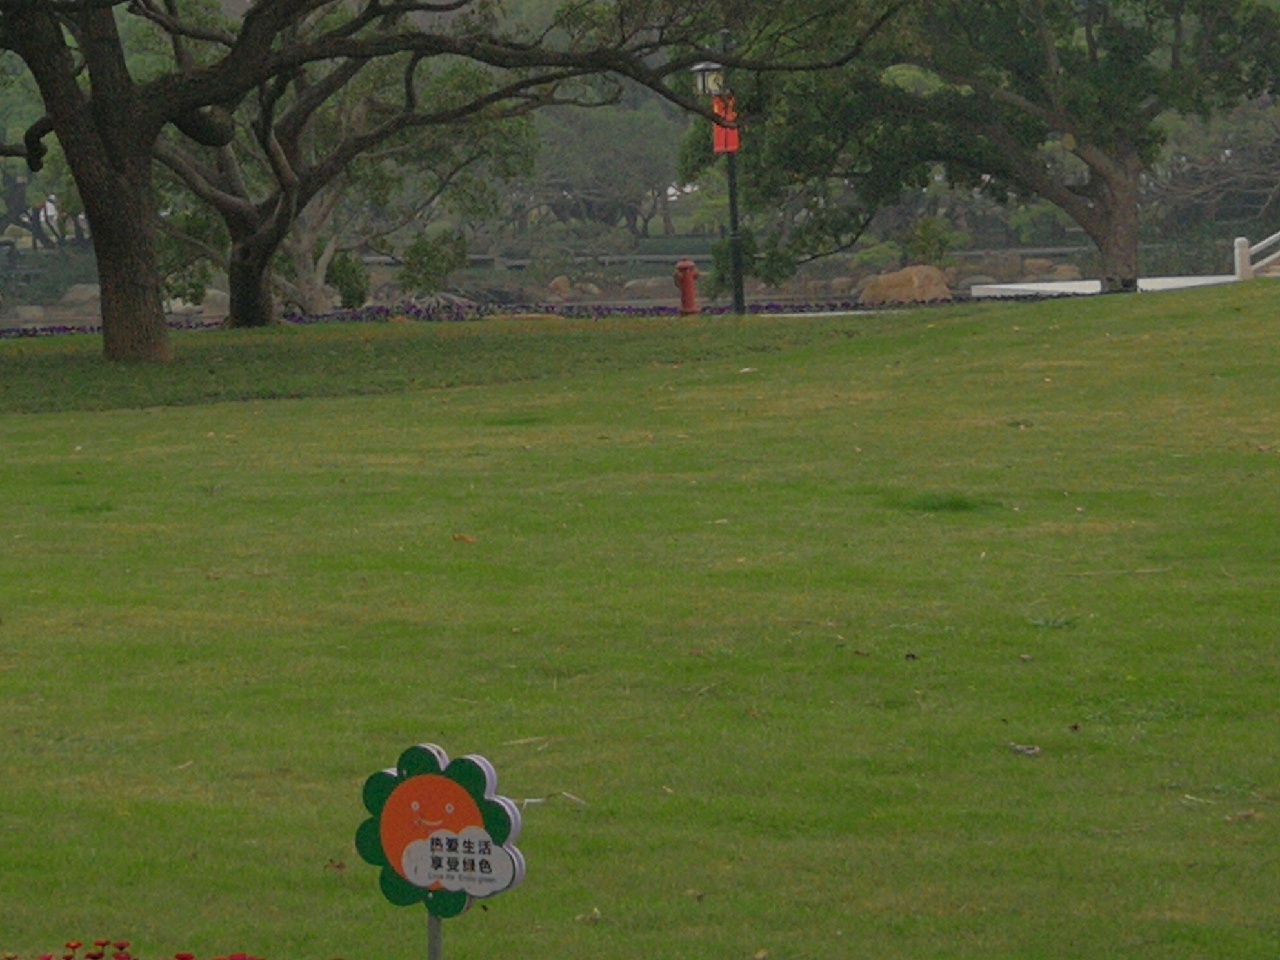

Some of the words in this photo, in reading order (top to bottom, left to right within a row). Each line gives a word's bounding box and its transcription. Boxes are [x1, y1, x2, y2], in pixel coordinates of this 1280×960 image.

[430, 837, 491, 855] 热爱生活
[430, 855, 492, 874] 享受绿色
